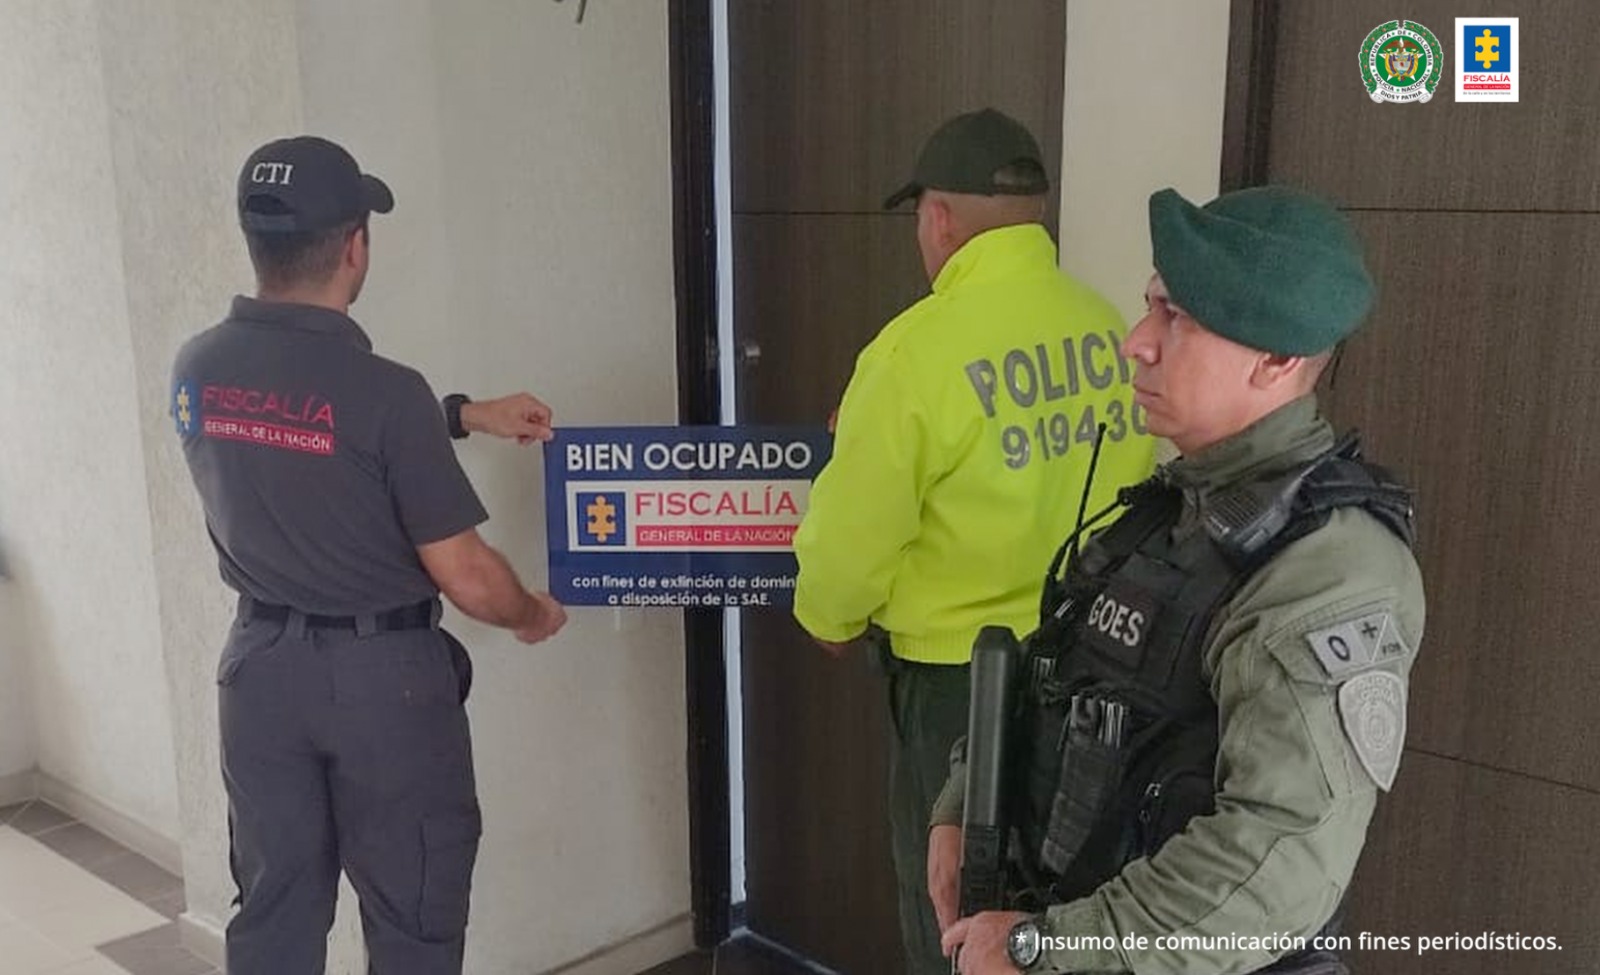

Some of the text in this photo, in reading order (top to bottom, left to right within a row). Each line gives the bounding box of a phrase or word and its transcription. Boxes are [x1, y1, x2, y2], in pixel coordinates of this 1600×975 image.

[252, 163, 293, 185] CTI
[965, 330, 1129, 418] POLICI
[204, 420, 330, 450] GENERAL DE LA NACIÓN
[567, 442, 812, 471] BIEN OCUPADO
[635, 486, 798, 516] FISCALÍA
[640, 530, 701, 542] GENERAL
[704, 530, 721, 541] DE
[725, 530, 742, 541] LA
[572, 575, 795, 588] con fines de extinción de domin
[608, 592, 772, 609] a disposición de la SAE.
[1088, 594, 1144, 646] GOES
